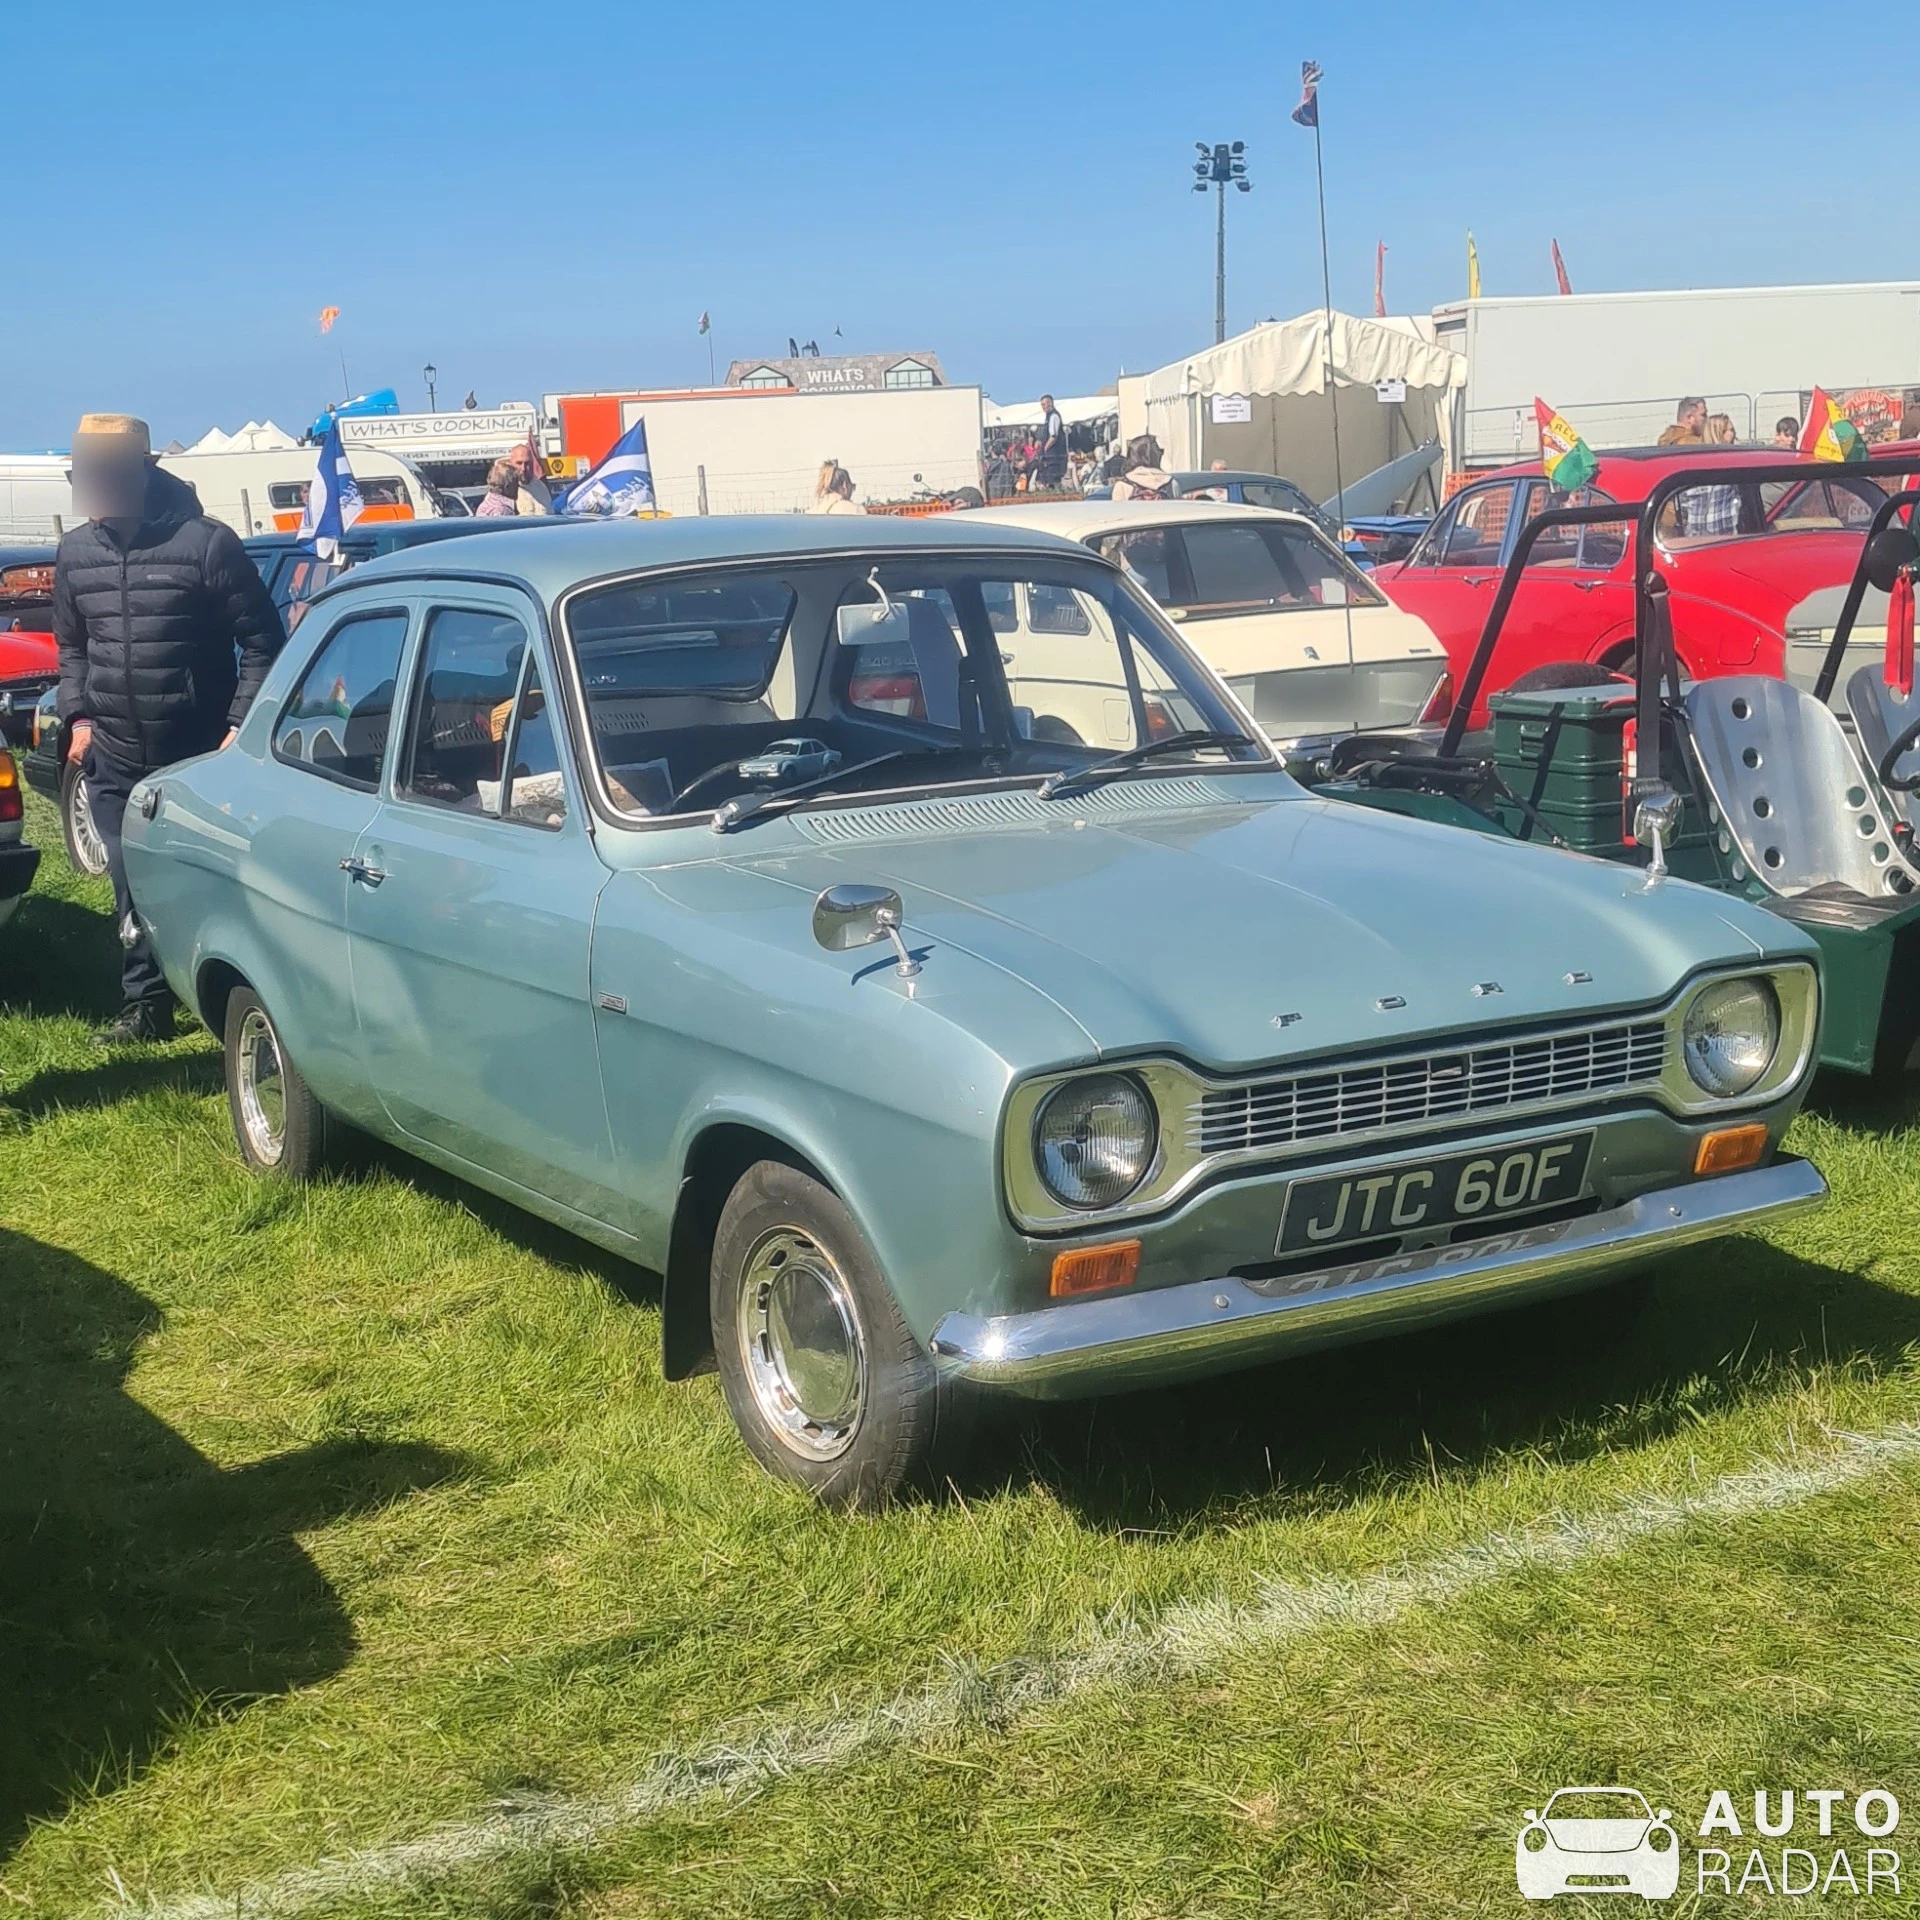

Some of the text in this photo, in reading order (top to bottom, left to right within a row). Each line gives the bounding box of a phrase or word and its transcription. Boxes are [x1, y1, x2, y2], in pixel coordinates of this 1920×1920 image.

[807, 369, 864, 384] WHATS
[350, 415, 527, 437] WHAT'S COOKING?
[1269, 969, 1594, 1030] FORD
[1306, 1143, 1574, 1241] JTC 60F
